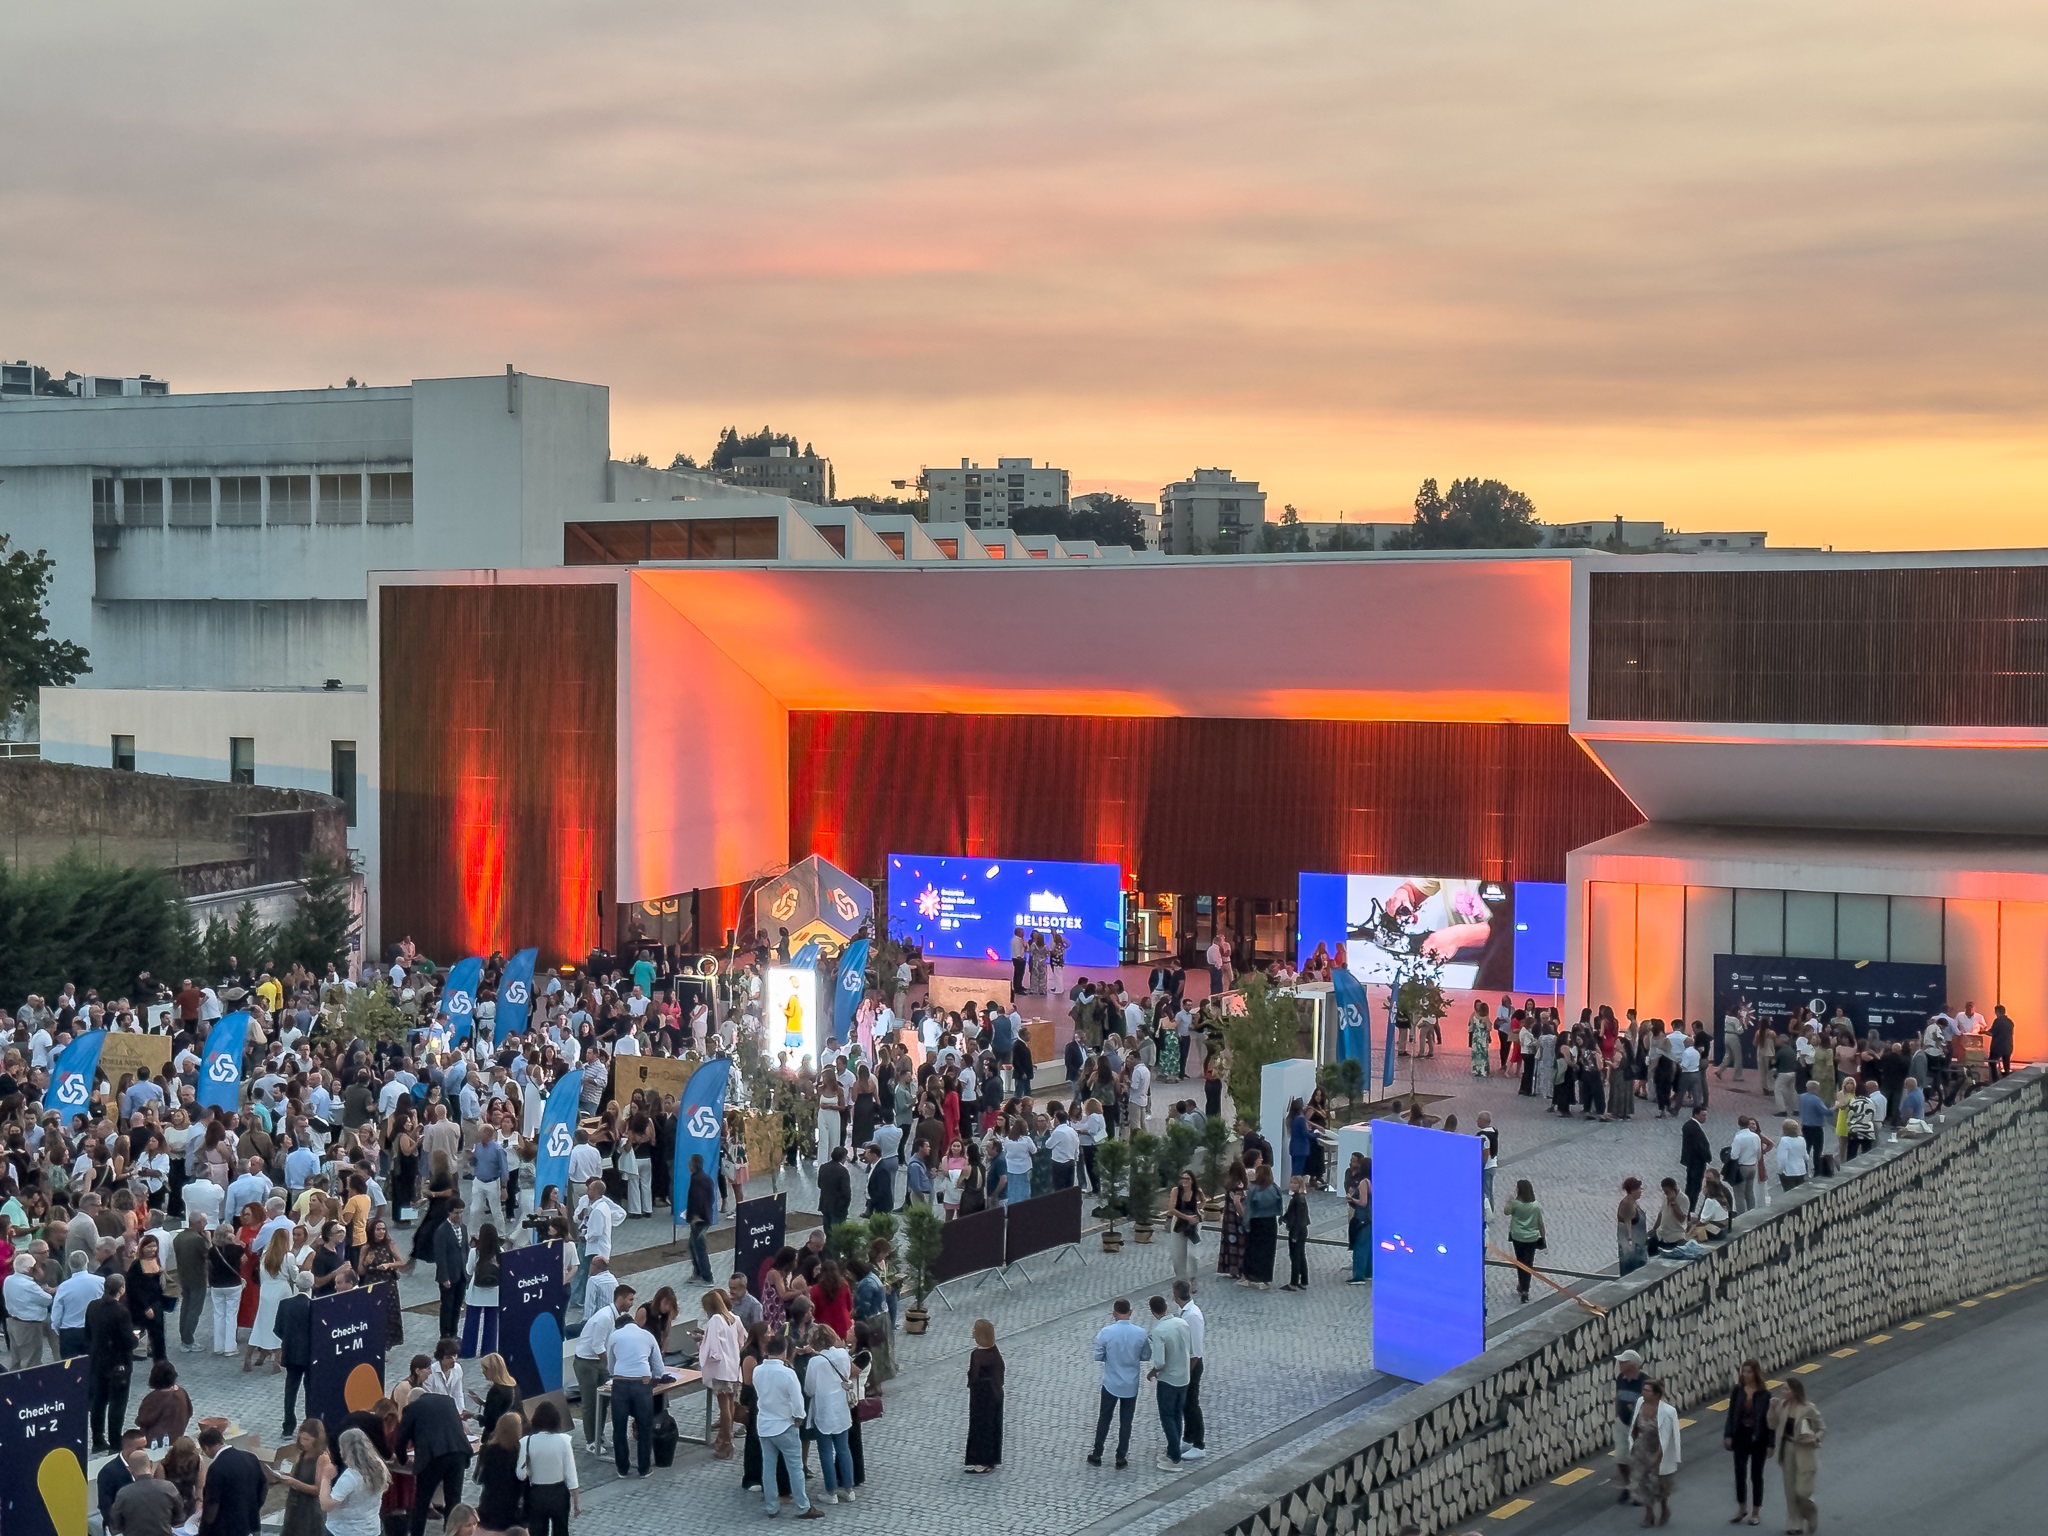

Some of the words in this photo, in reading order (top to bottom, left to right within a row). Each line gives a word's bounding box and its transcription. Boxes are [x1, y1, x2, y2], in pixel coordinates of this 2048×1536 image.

[1015, 914, 1082, 929] BELISOTEX
[750, 1222, 774, 1235] Check-in
[753, 1239, 759, 1248] A
[765, 1236, 770, 1245] C
[517, 1274, 549, 1288] Check-in
[523, 1292, 530, 1303] D
[538, 1289, 543, 1299] J
[331, 1321, 368, 1339] Check-in
[336, 1344, 342, 1355] L
[352, 1337, 363, 1350] M
[18, 1401, 65, 1420] Check-in
[26, 1424, 36, 1438] N
[49, 1419, 58, 1432] Z
